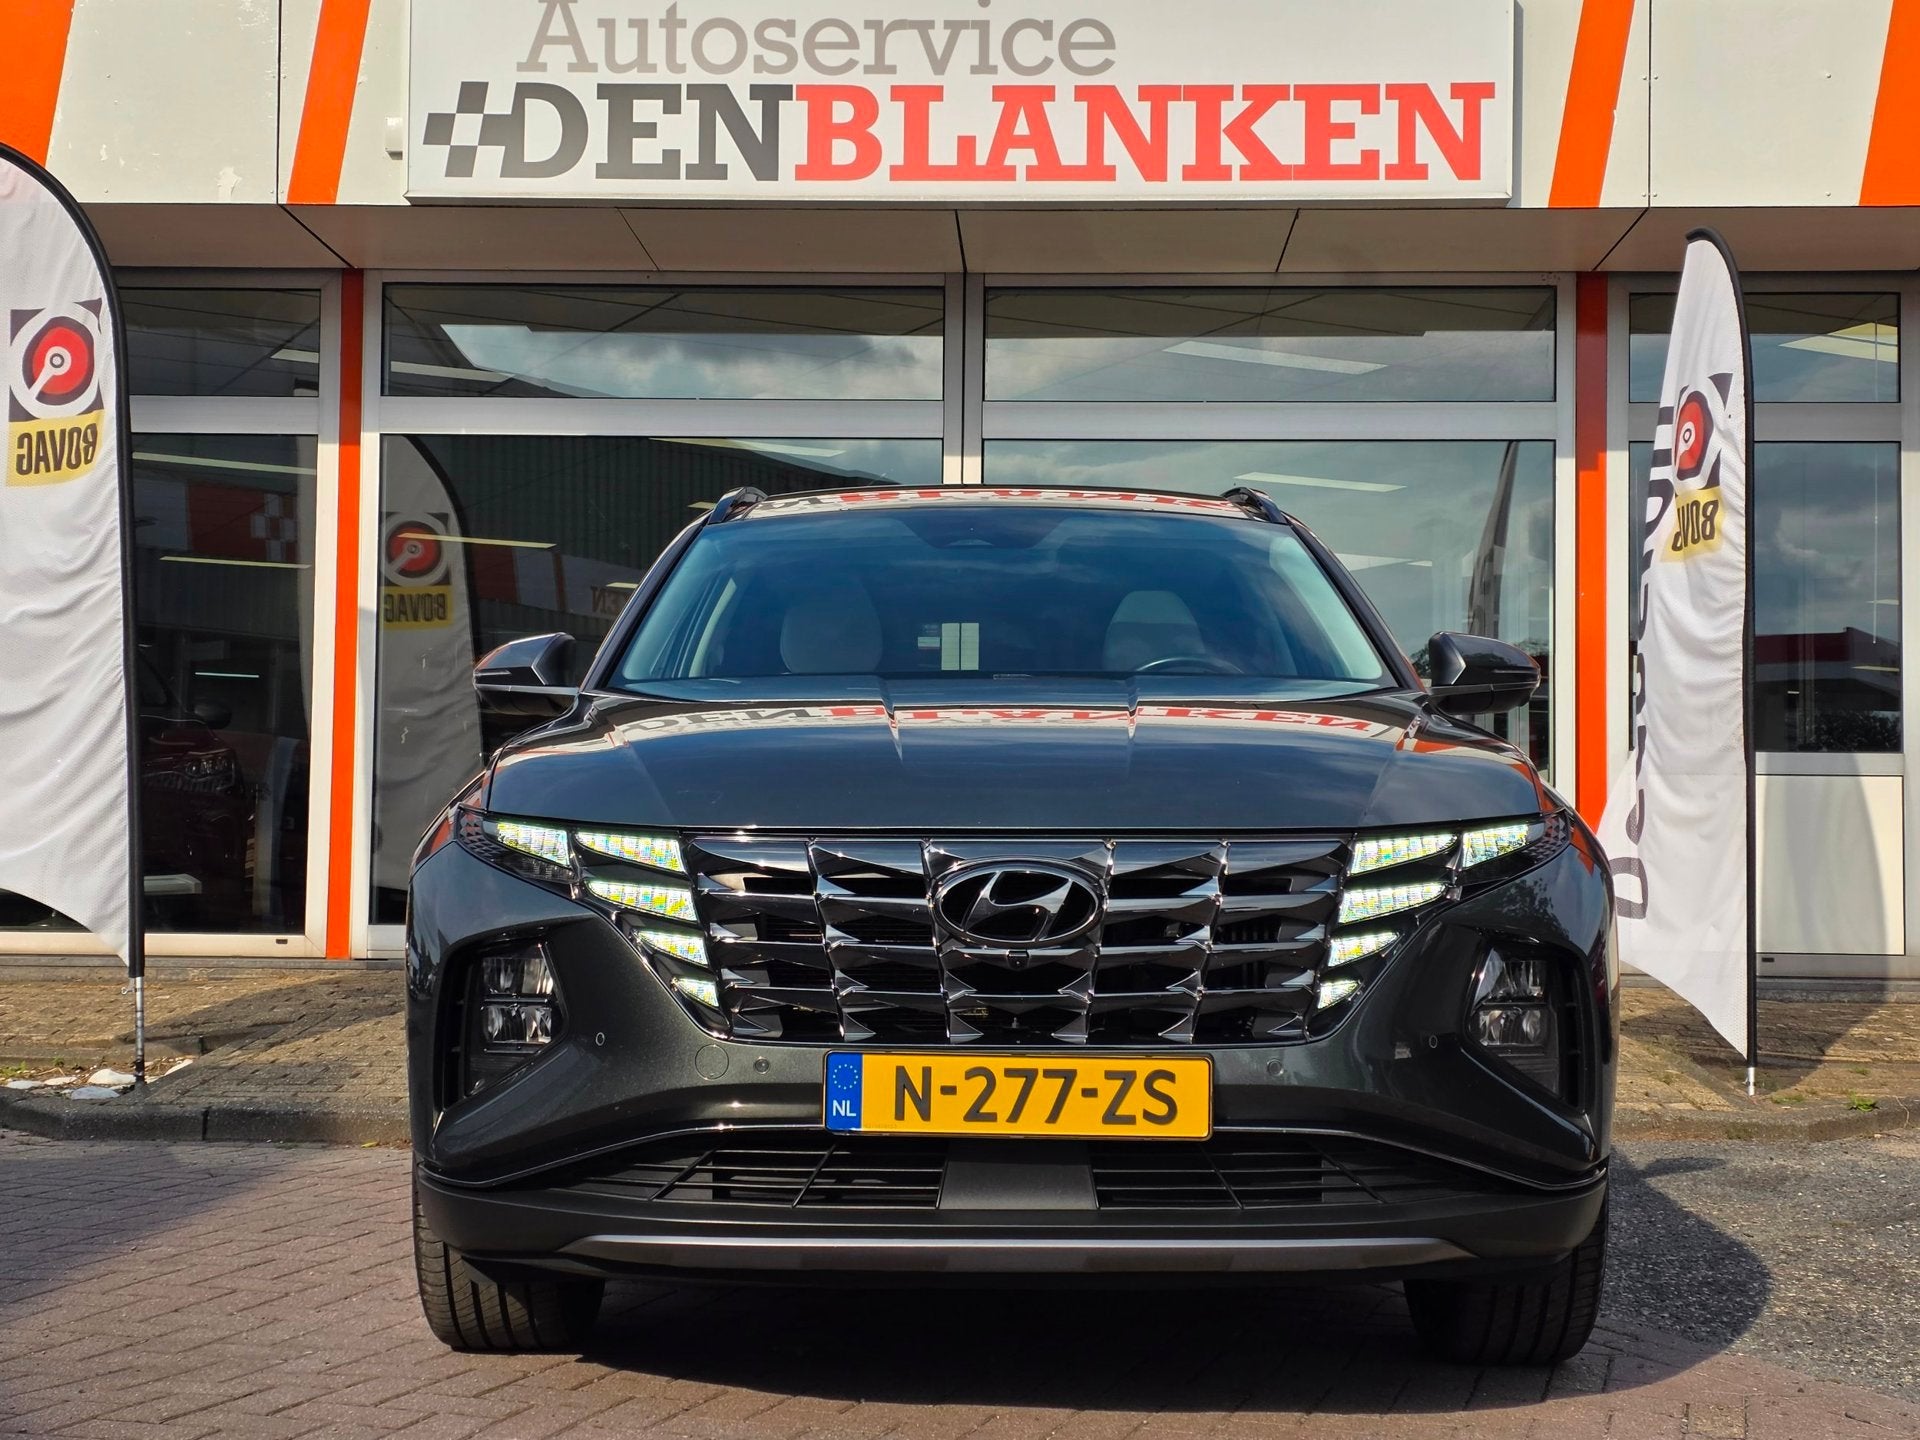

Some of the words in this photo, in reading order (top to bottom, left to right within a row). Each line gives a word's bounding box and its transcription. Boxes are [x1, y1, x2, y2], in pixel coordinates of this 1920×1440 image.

[516, 0, 1116, 76] Autoservice
[832, 1100, 856, 1117] NL
[894, 1065, 1178, 1125] N-277-ZS
